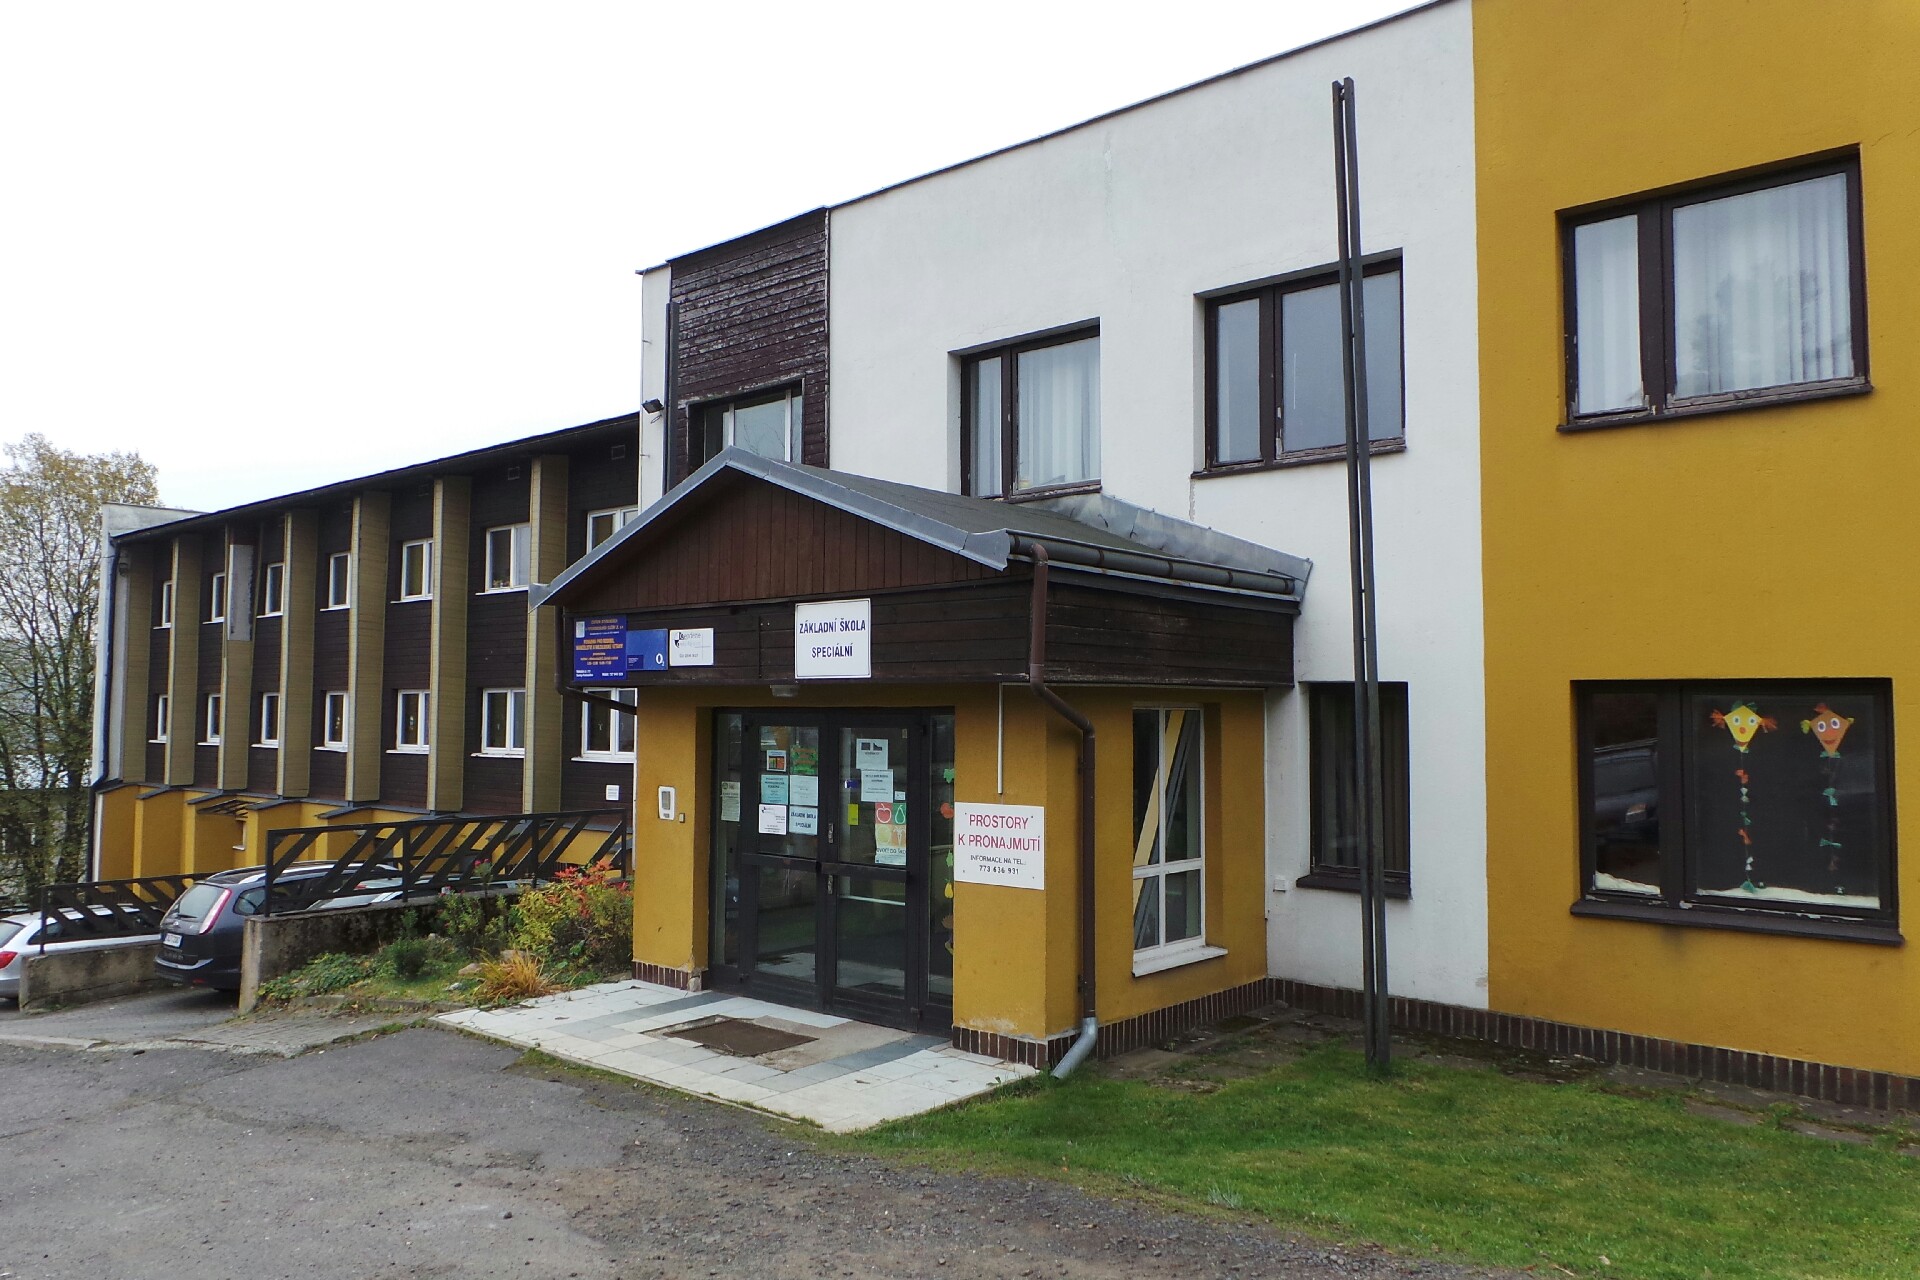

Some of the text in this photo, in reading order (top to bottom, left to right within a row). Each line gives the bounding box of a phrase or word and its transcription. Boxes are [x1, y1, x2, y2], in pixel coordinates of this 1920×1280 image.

[799, 617, 866, 634] ZÁKLADNÍ ŠKOLA
[811, 643, 853, 658] SPECIÁLNÍ
[969, 814, 1029, 829] PROSTORY
[958, 834, 1040, 852] K PRONAJMUTÍ
[970, 855, 1002, 864] INFORMACE
[979, 865, 991, 873] 773
[1007, 867, 1019, 875] 931
